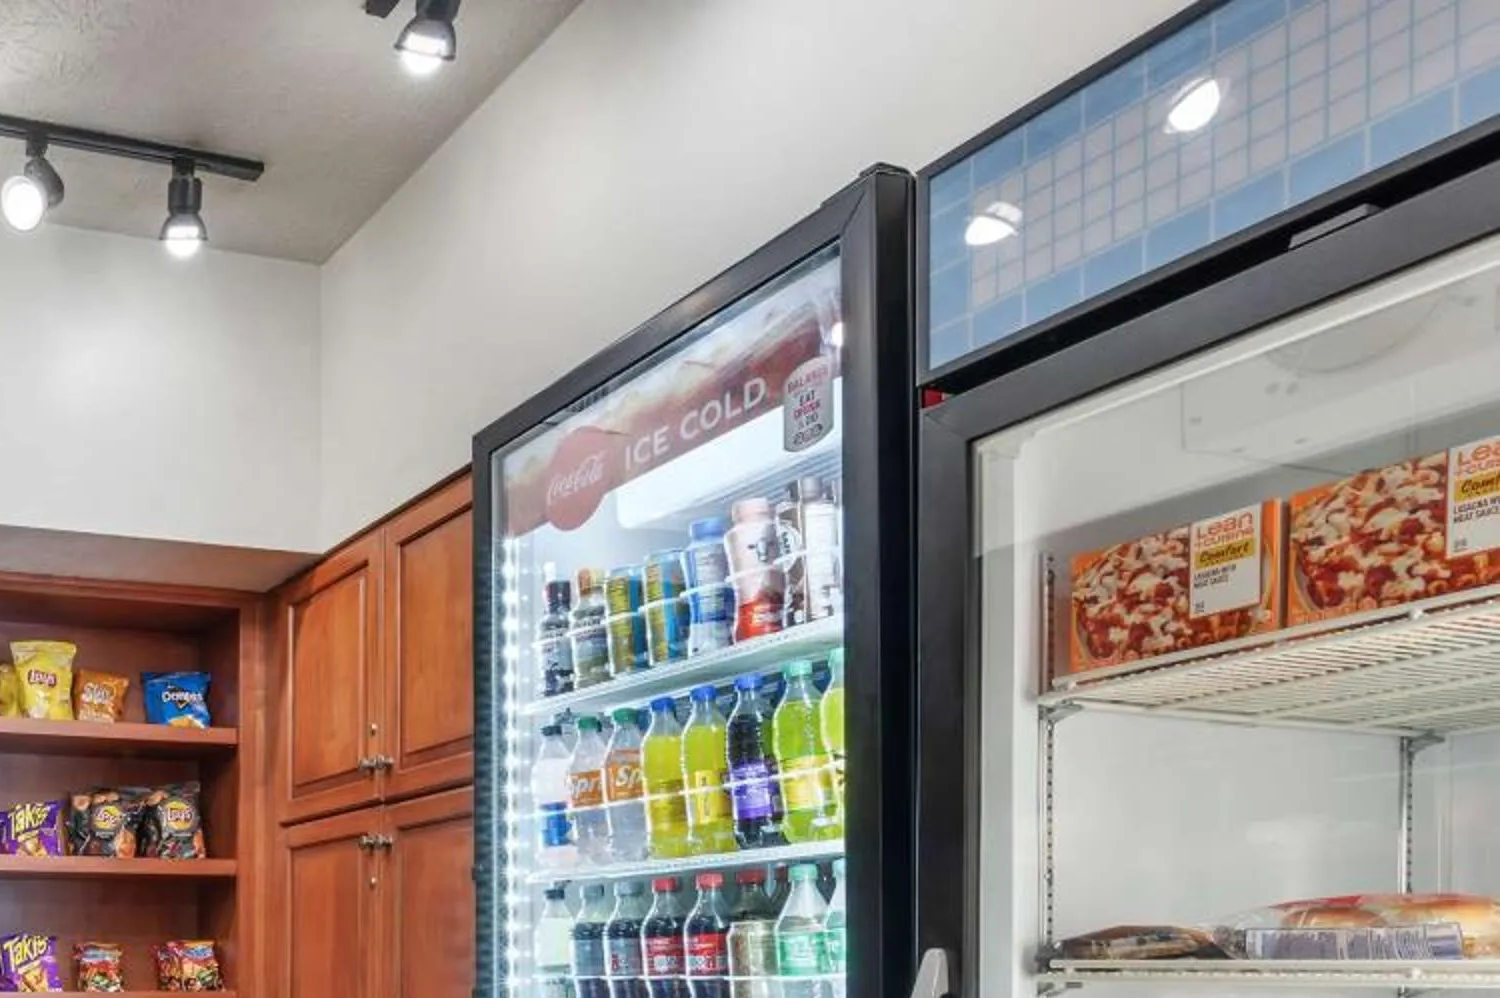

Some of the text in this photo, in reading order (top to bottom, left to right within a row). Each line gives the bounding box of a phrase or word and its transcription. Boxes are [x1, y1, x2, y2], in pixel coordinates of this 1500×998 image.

[625, 425, 671, 471] ICE
[679, 376, 767, 441] COLD
[1197, 511, 1253, 540] Lean
[4, 935, 48, 973] Takis
